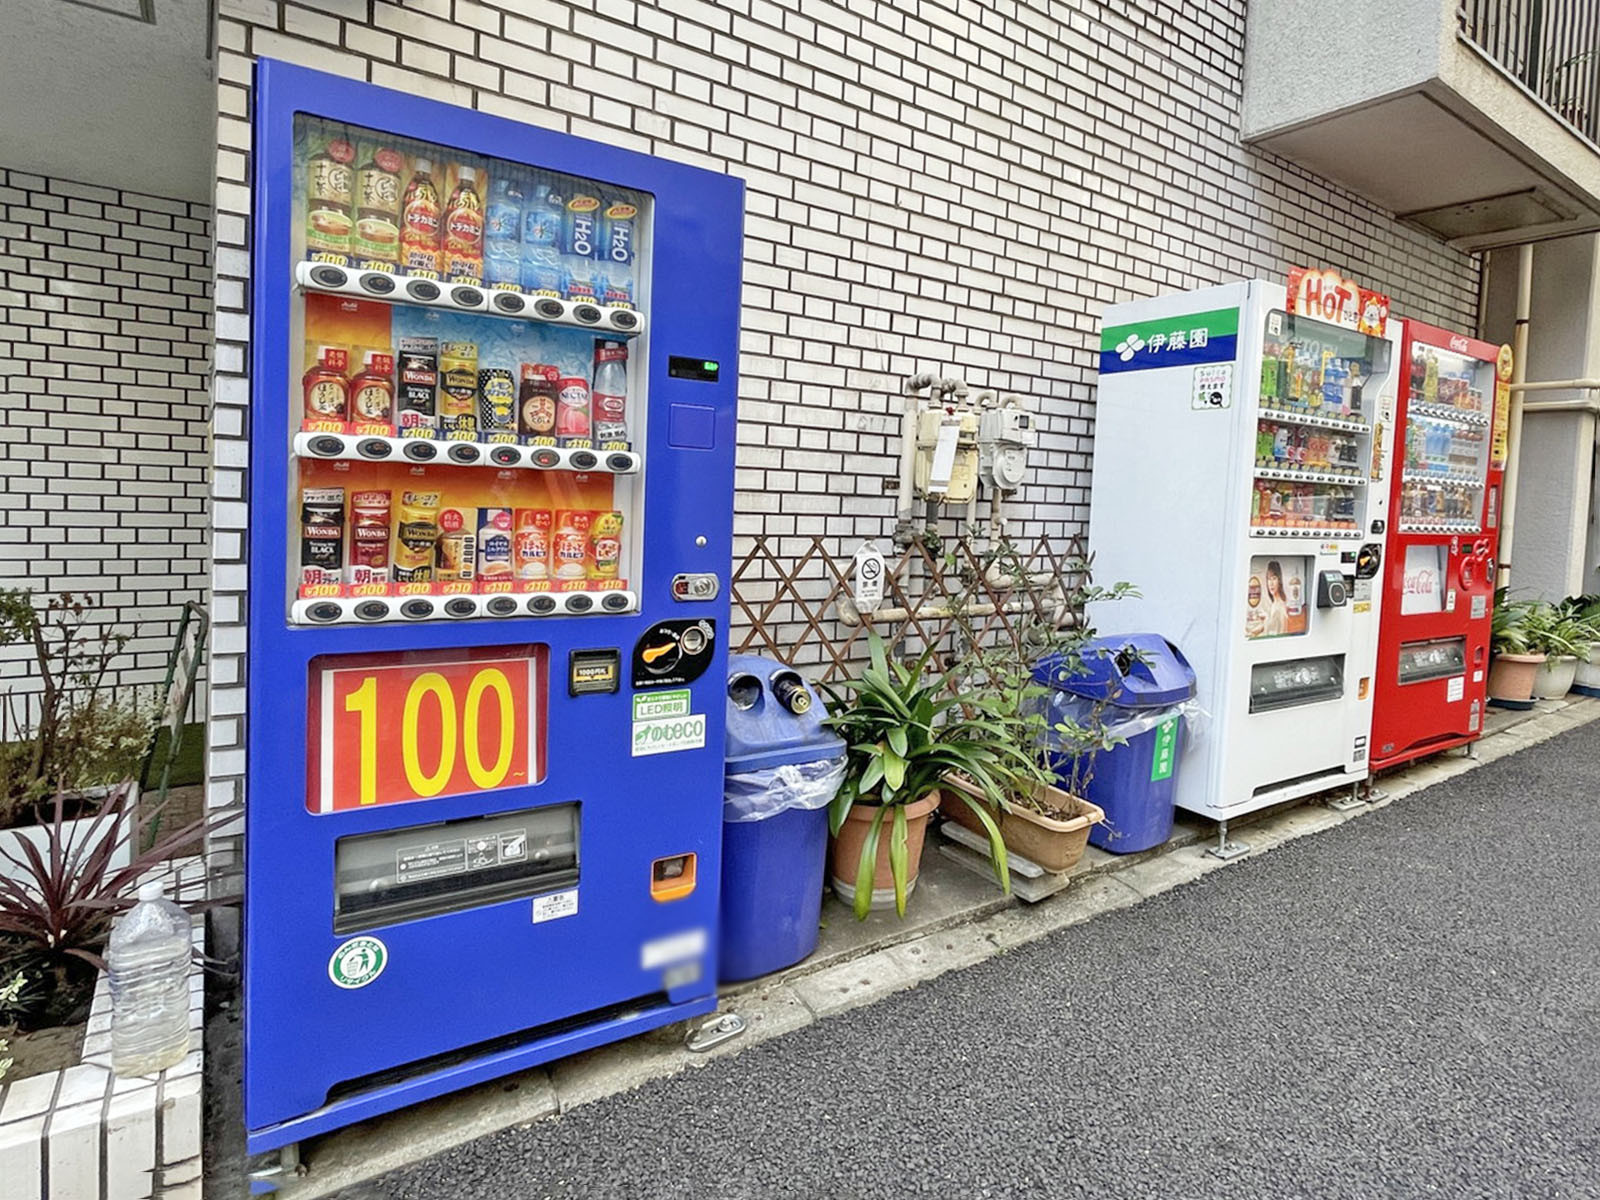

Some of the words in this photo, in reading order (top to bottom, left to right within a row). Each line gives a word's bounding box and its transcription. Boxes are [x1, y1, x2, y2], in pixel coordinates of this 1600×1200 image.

[574, 218, 592, 255] H2O
[612, 225, 629, 262] H2O
[1147, 328, 1208, 353] 伊藤園
[307, 527, 338, 536] WONDA
[357, 528, 387, 537] WONDA
[640, 702, 683, 715] LED照明
